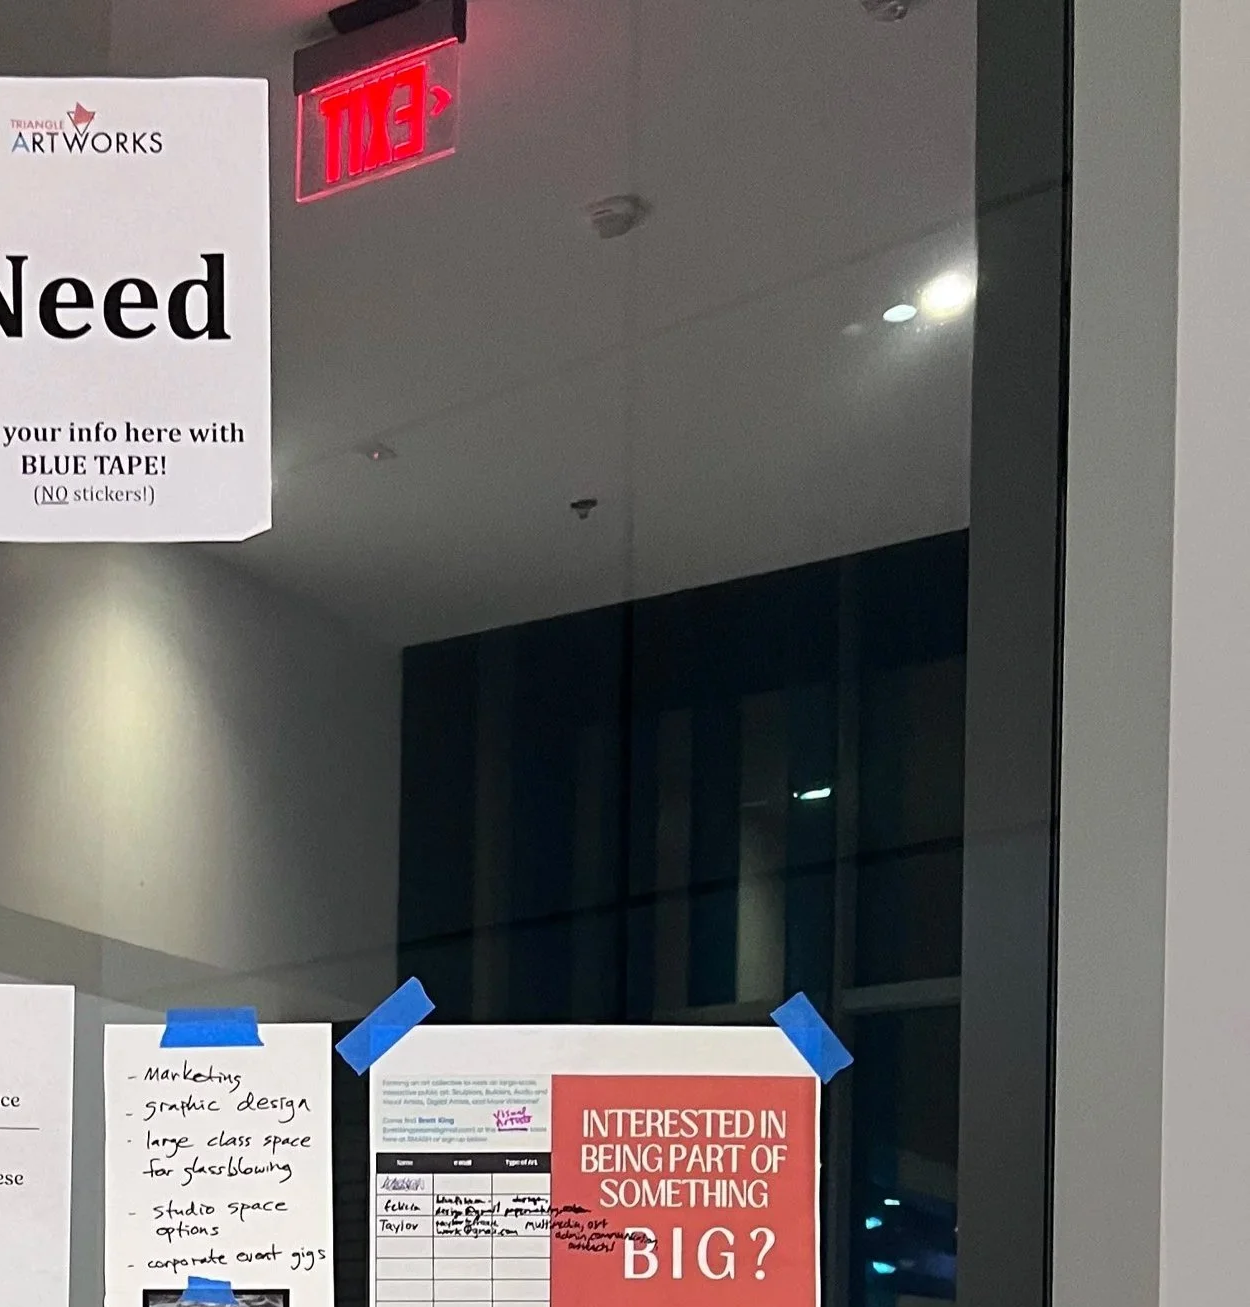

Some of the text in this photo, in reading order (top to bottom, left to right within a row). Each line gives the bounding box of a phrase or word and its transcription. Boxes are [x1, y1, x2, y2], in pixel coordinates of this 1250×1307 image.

[11, 120, 62, 129] TRIANGLE
[3, 427, 61, 447] your
[70, 422, 116, 442] info
[126, 422, 181, 442] here
[190, 423, 243, 442] with
[22, 455, 165, 475] BLUE TAPE!
[35, 486, 154, 505] (NO stickers!)
[144, 1060, 241, 1093] Marketing
[144, 1092, 310, 1123] graphic design
[584, 1109, 786, 1138] INTERESTED IN
[147, 1131, 310, 1158] large class space
[581, 1144, 787, 1173] BEING PART OF
[600, 1179, 768, 1208] SOMETHING
[379, 1219, 419, 1232] Taylor
[620, 1227, 775, 1280] BIG?
